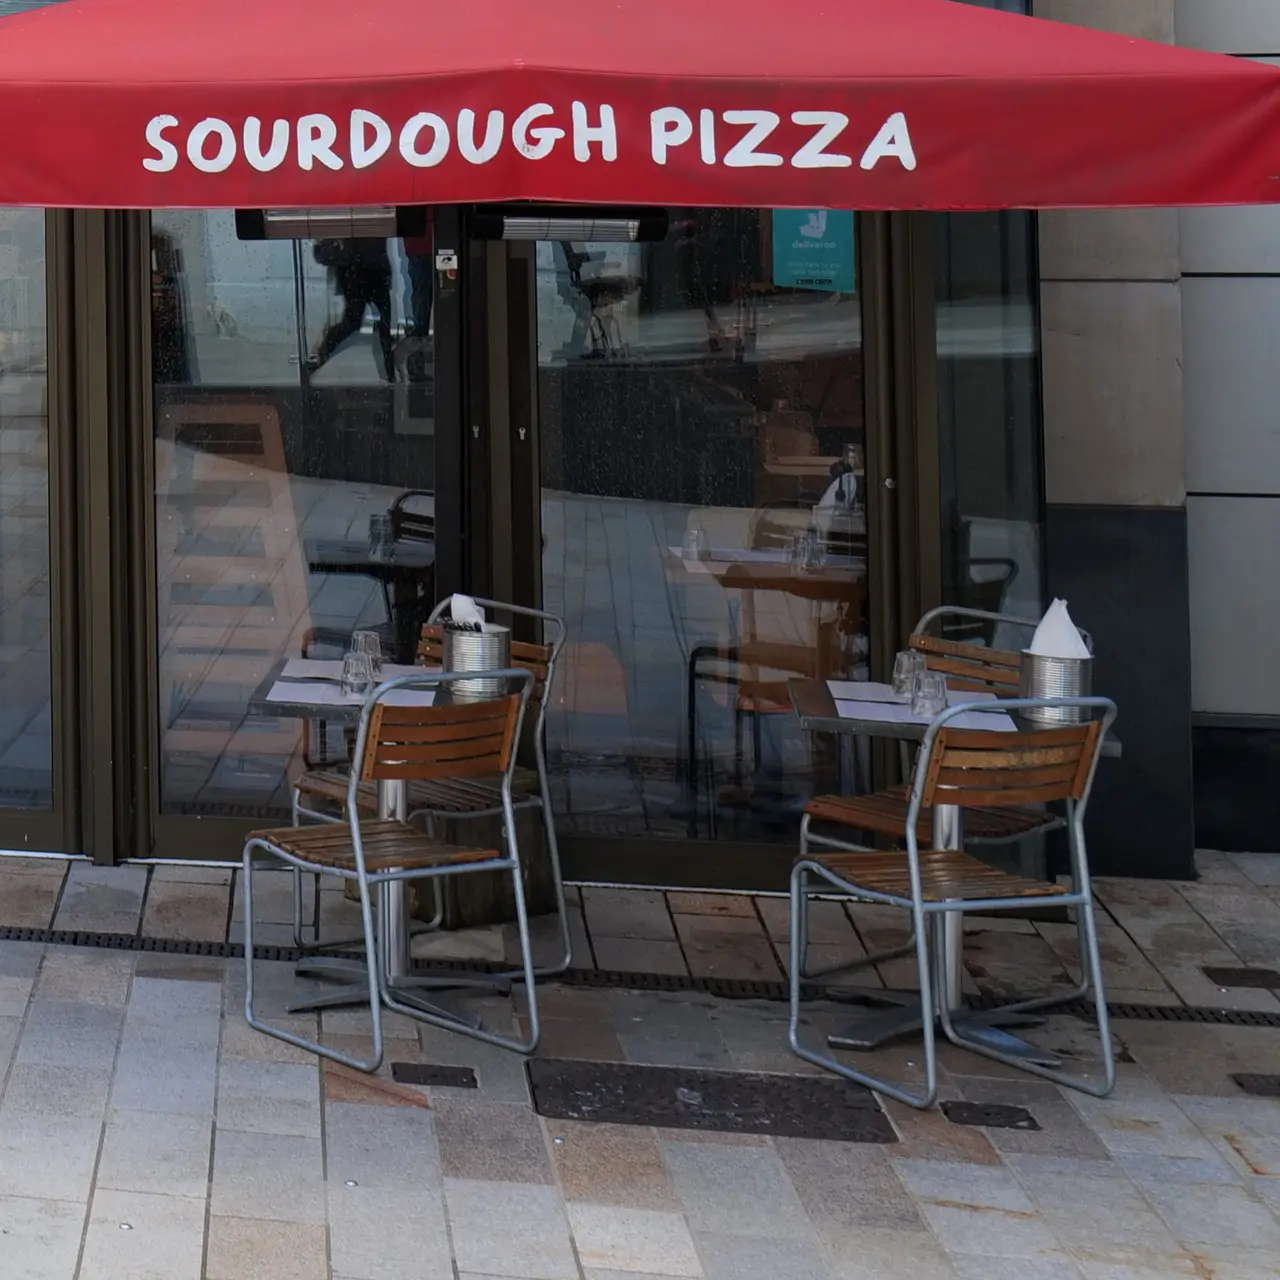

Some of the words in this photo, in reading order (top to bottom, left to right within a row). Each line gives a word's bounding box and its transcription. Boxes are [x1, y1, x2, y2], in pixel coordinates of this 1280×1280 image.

[142, 100, 618, 173] SOURDOUGH
[650, 106, 917, 171] PIZZA
[792, 239, 836, 249] deliveroo
